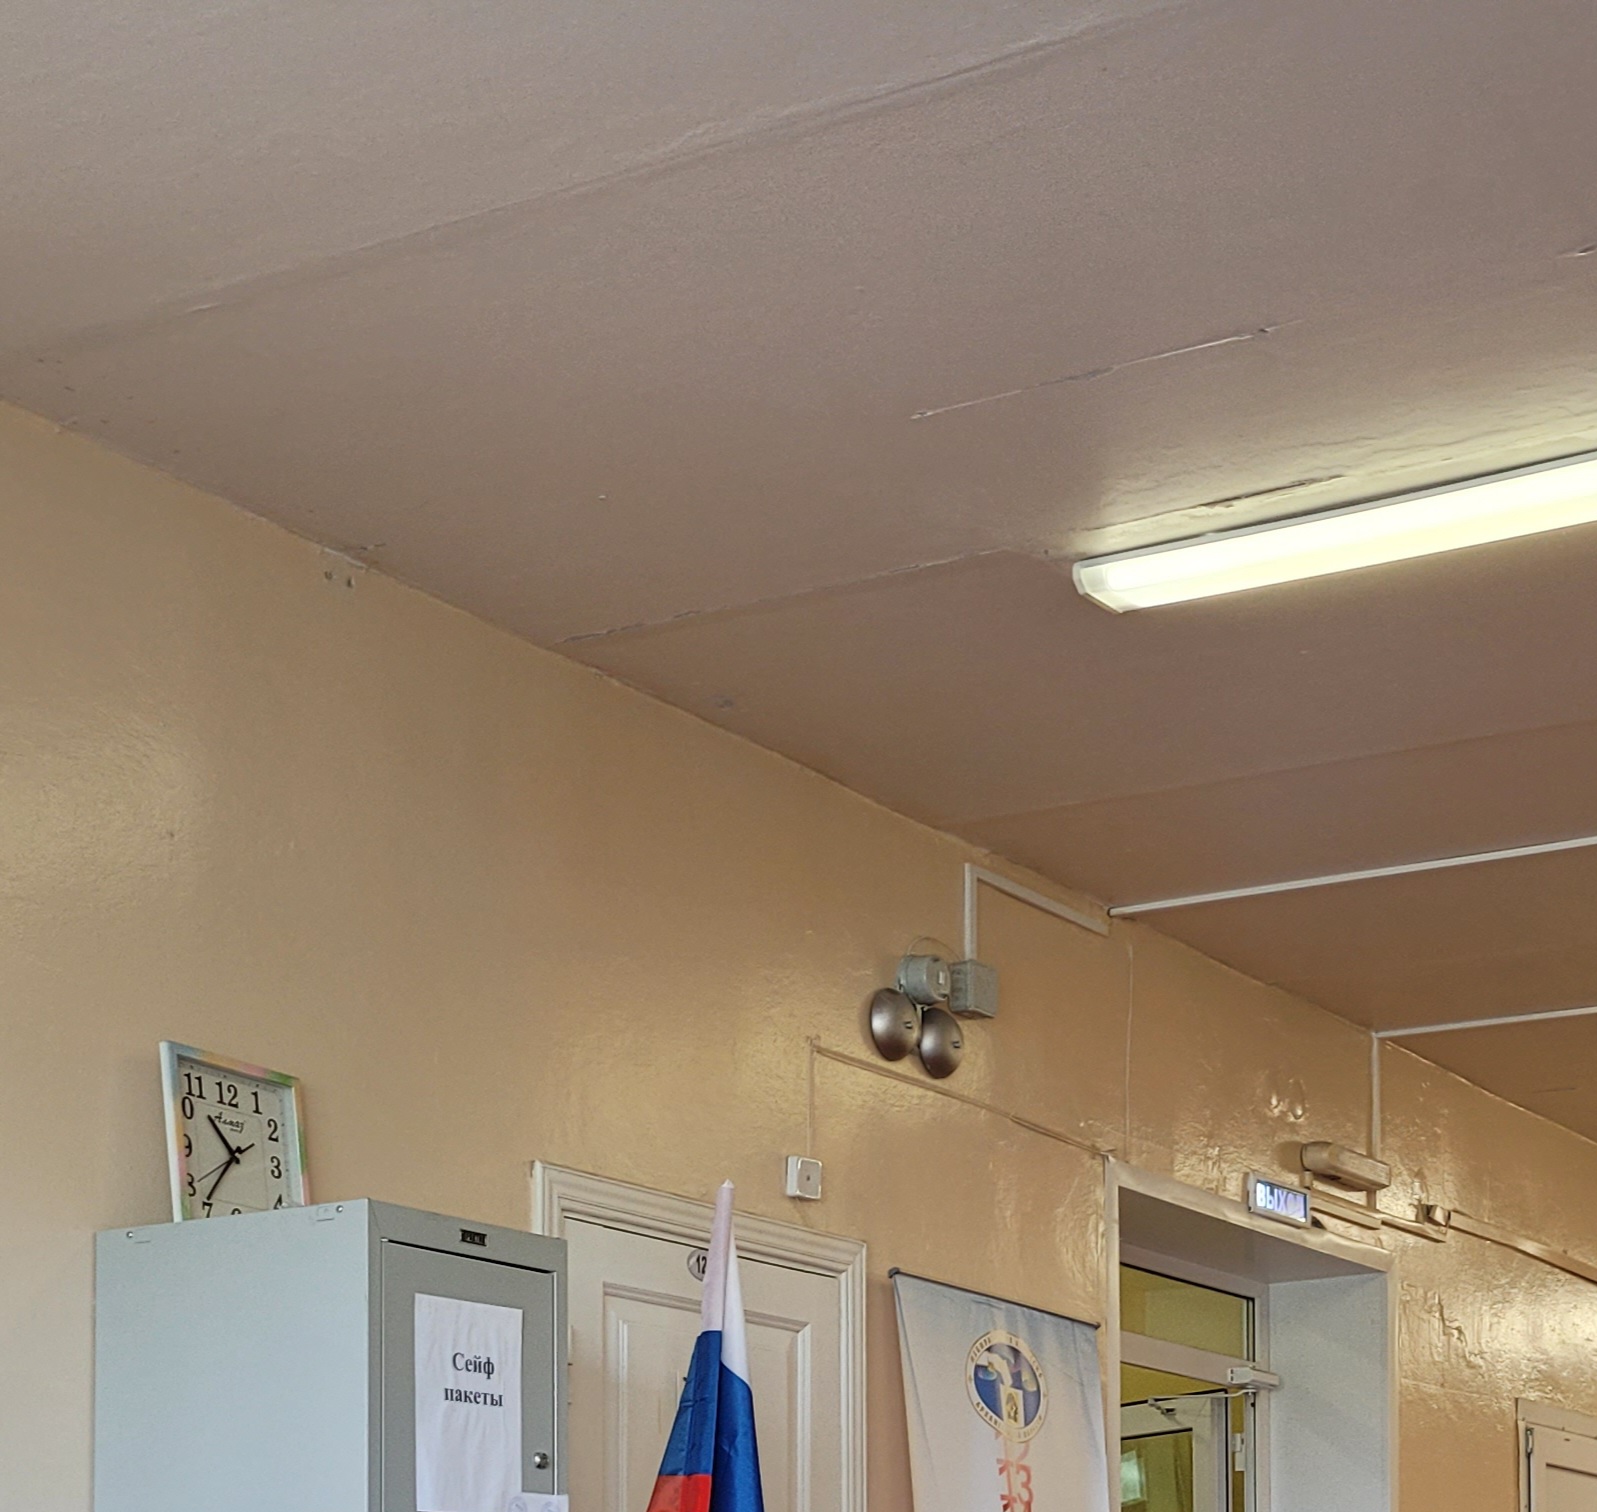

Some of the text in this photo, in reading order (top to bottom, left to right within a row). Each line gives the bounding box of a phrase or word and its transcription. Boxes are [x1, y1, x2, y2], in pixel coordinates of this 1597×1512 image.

[184, 1072, 206, 1100] 11
[215, 1081, 239, 1109] 12
[181, 1096, 194, 1119] 0
[251, 1091, 263, 1115] 1
[267, 1118, 279, 1143] 2
[270, 1156, 282, 1179] 3
[452, 1352, 495, 1379] Сейф
[444, 1387, 503, 1407] пакеты
[998, 1459, 1034, 1504] 13
